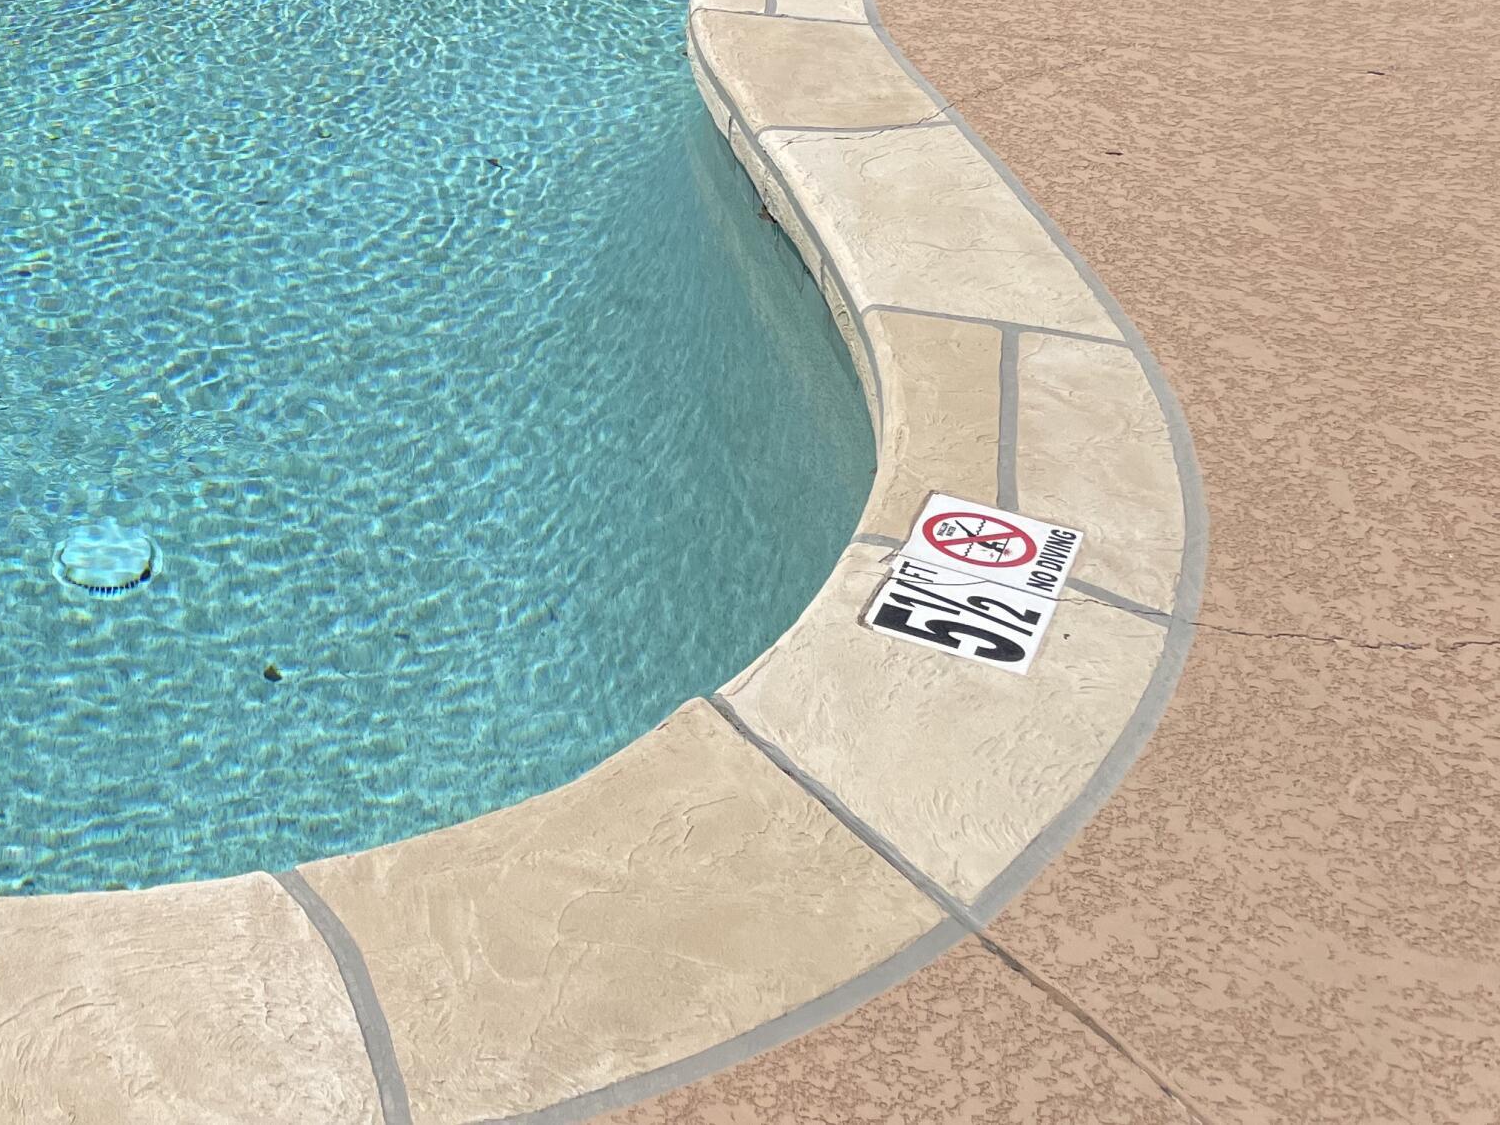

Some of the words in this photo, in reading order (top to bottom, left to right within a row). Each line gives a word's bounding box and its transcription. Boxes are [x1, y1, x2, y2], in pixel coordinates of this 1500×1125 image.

[1036, 529, 1078, 573] DIVING
[898, 561, 938, 583] FT
[1027, 572, 1059, 592] NO
